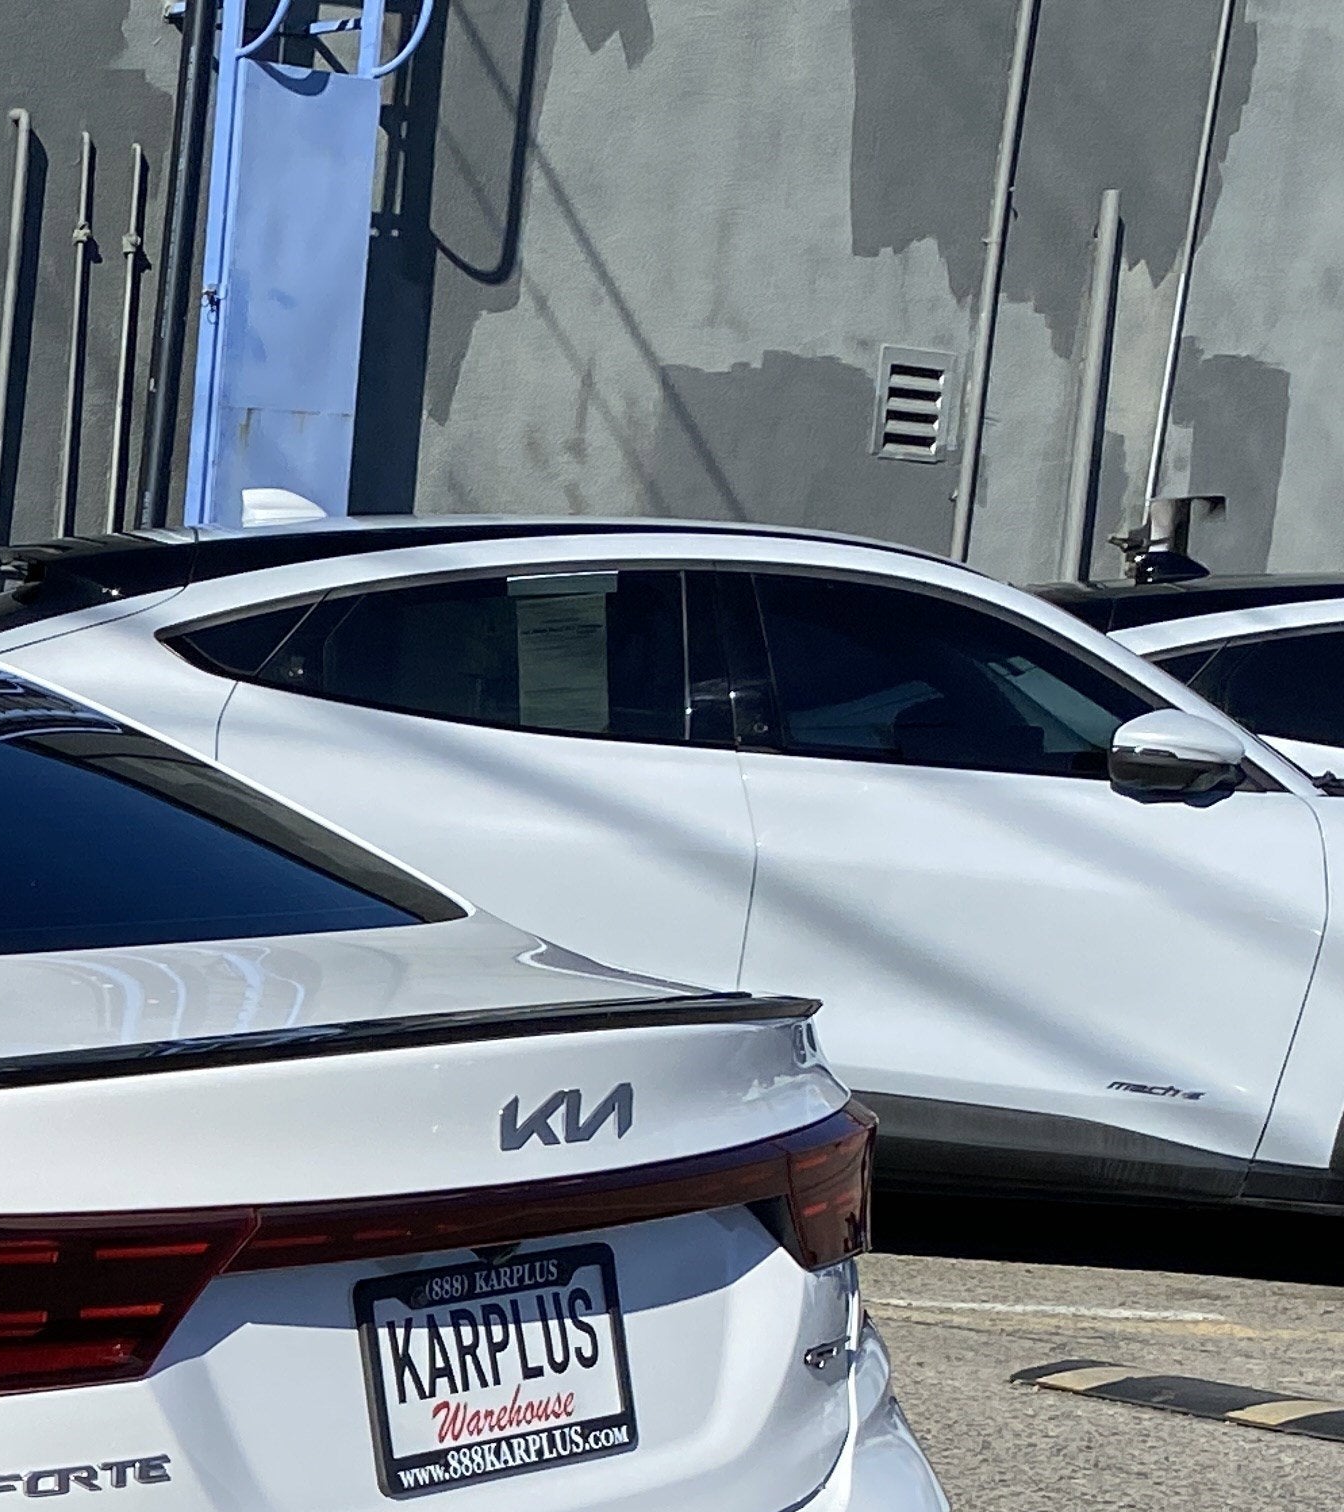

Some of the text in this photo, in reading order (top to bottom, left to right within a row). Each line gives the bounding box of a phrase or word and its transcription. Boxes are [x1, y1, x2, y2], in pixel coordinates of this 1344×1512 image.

[499, 1082, 633, 1151] KIA
[425, 1259, 558, 1301] (888) KARPLUS
[386, 1287, 599, 1404] KARPLUS
[431, 1383, 575, 1444] Warehouse
